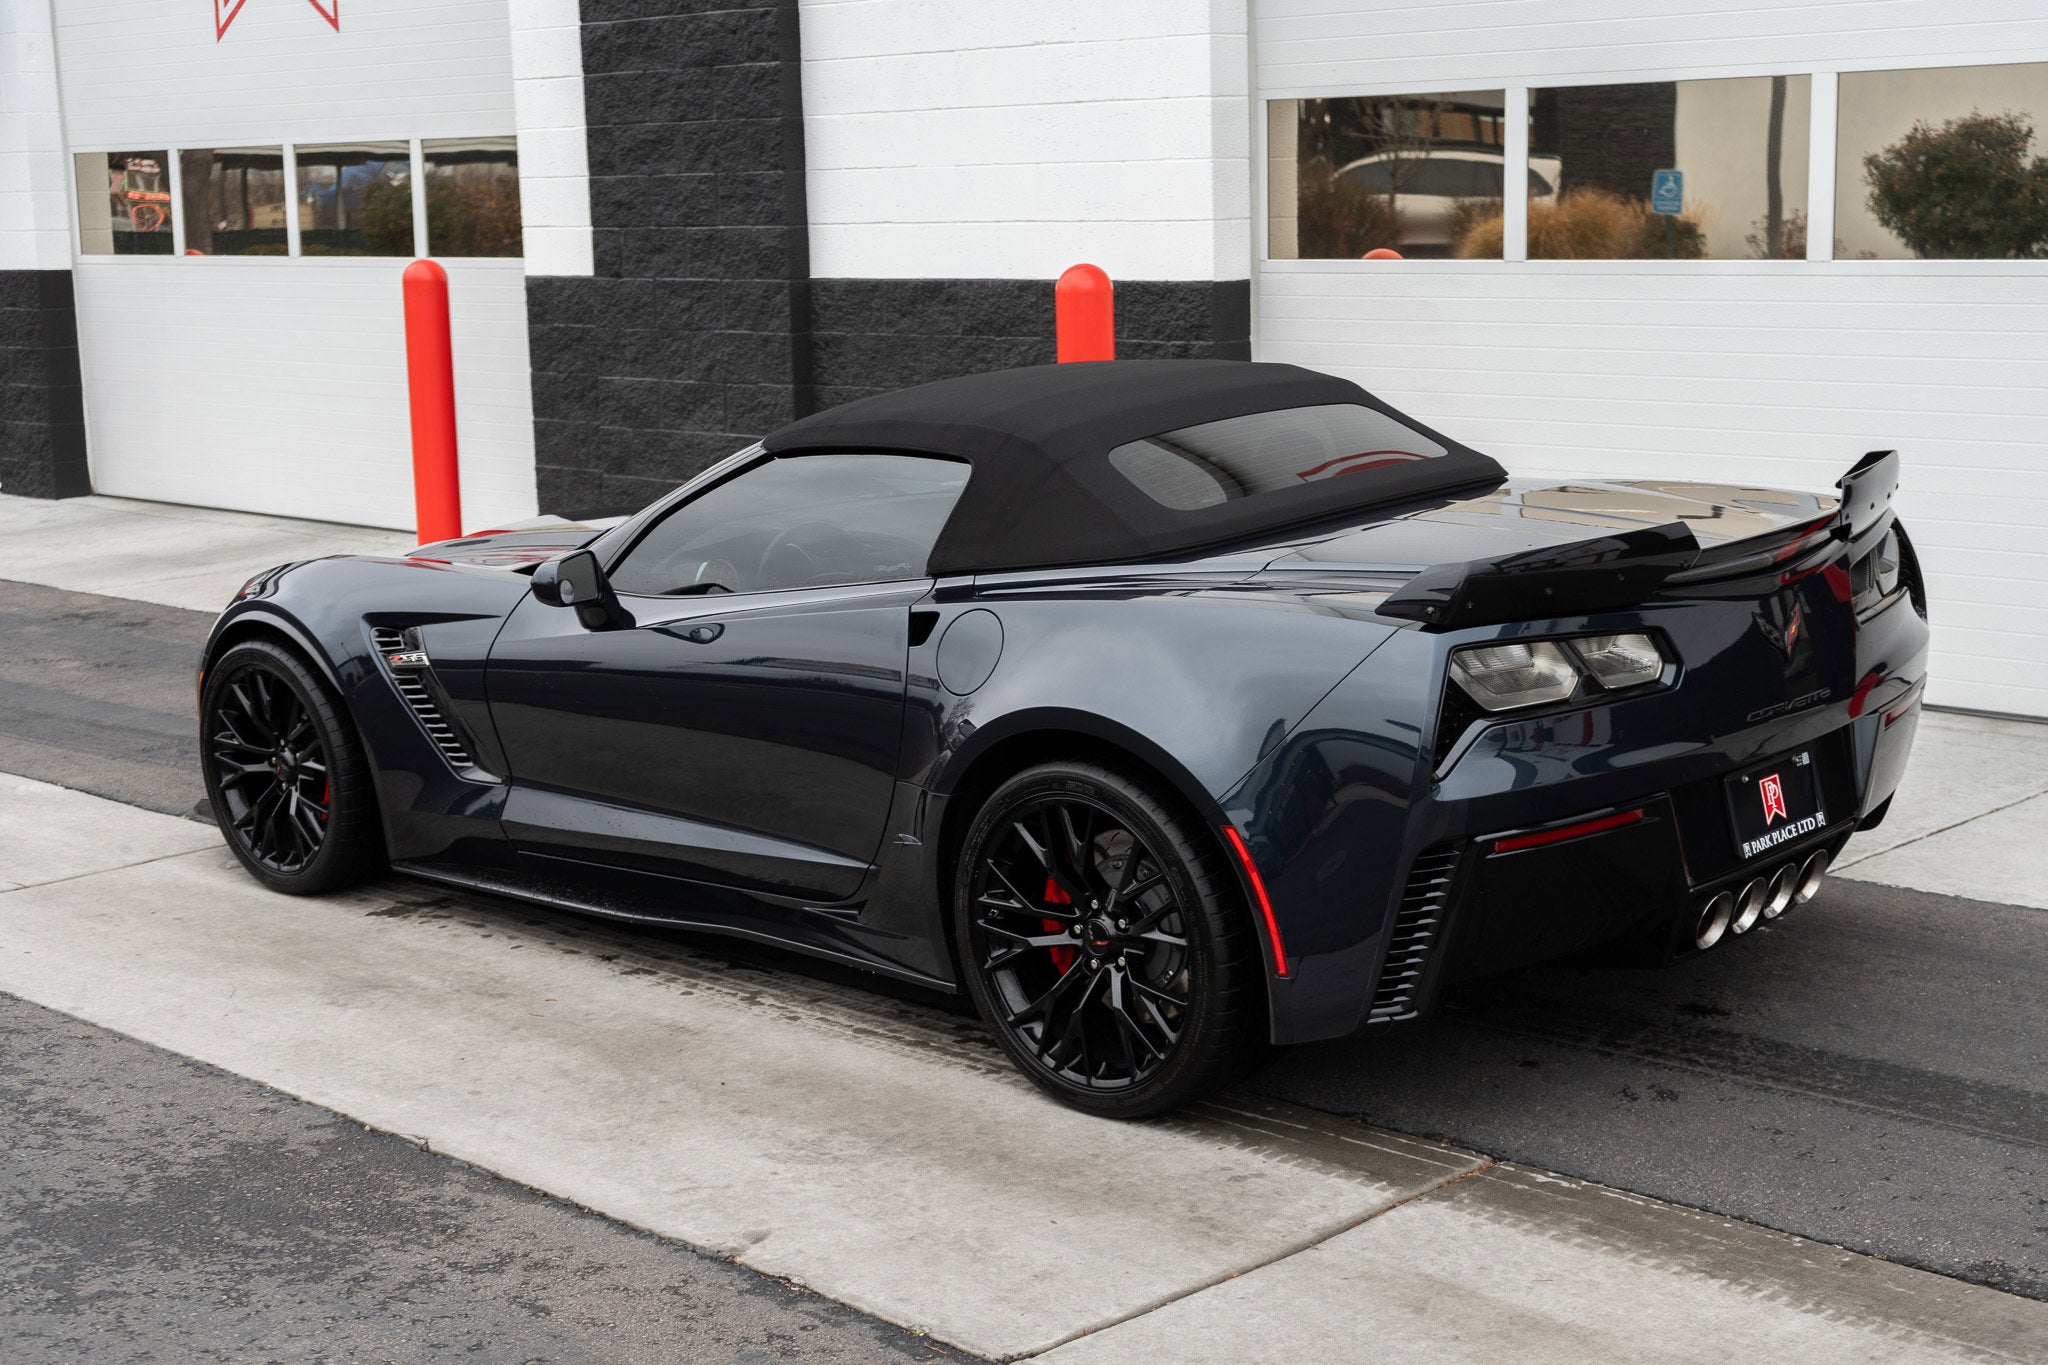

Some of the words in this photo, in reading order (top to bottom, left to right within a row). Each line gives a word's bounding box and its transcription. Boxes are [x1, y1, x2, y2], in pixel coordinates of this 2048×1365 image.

[1751, 835, 1773, 854] PARK
[1771, 824, 1798, 845] PLACE
[1797, 817, 1816, 834] LTD
